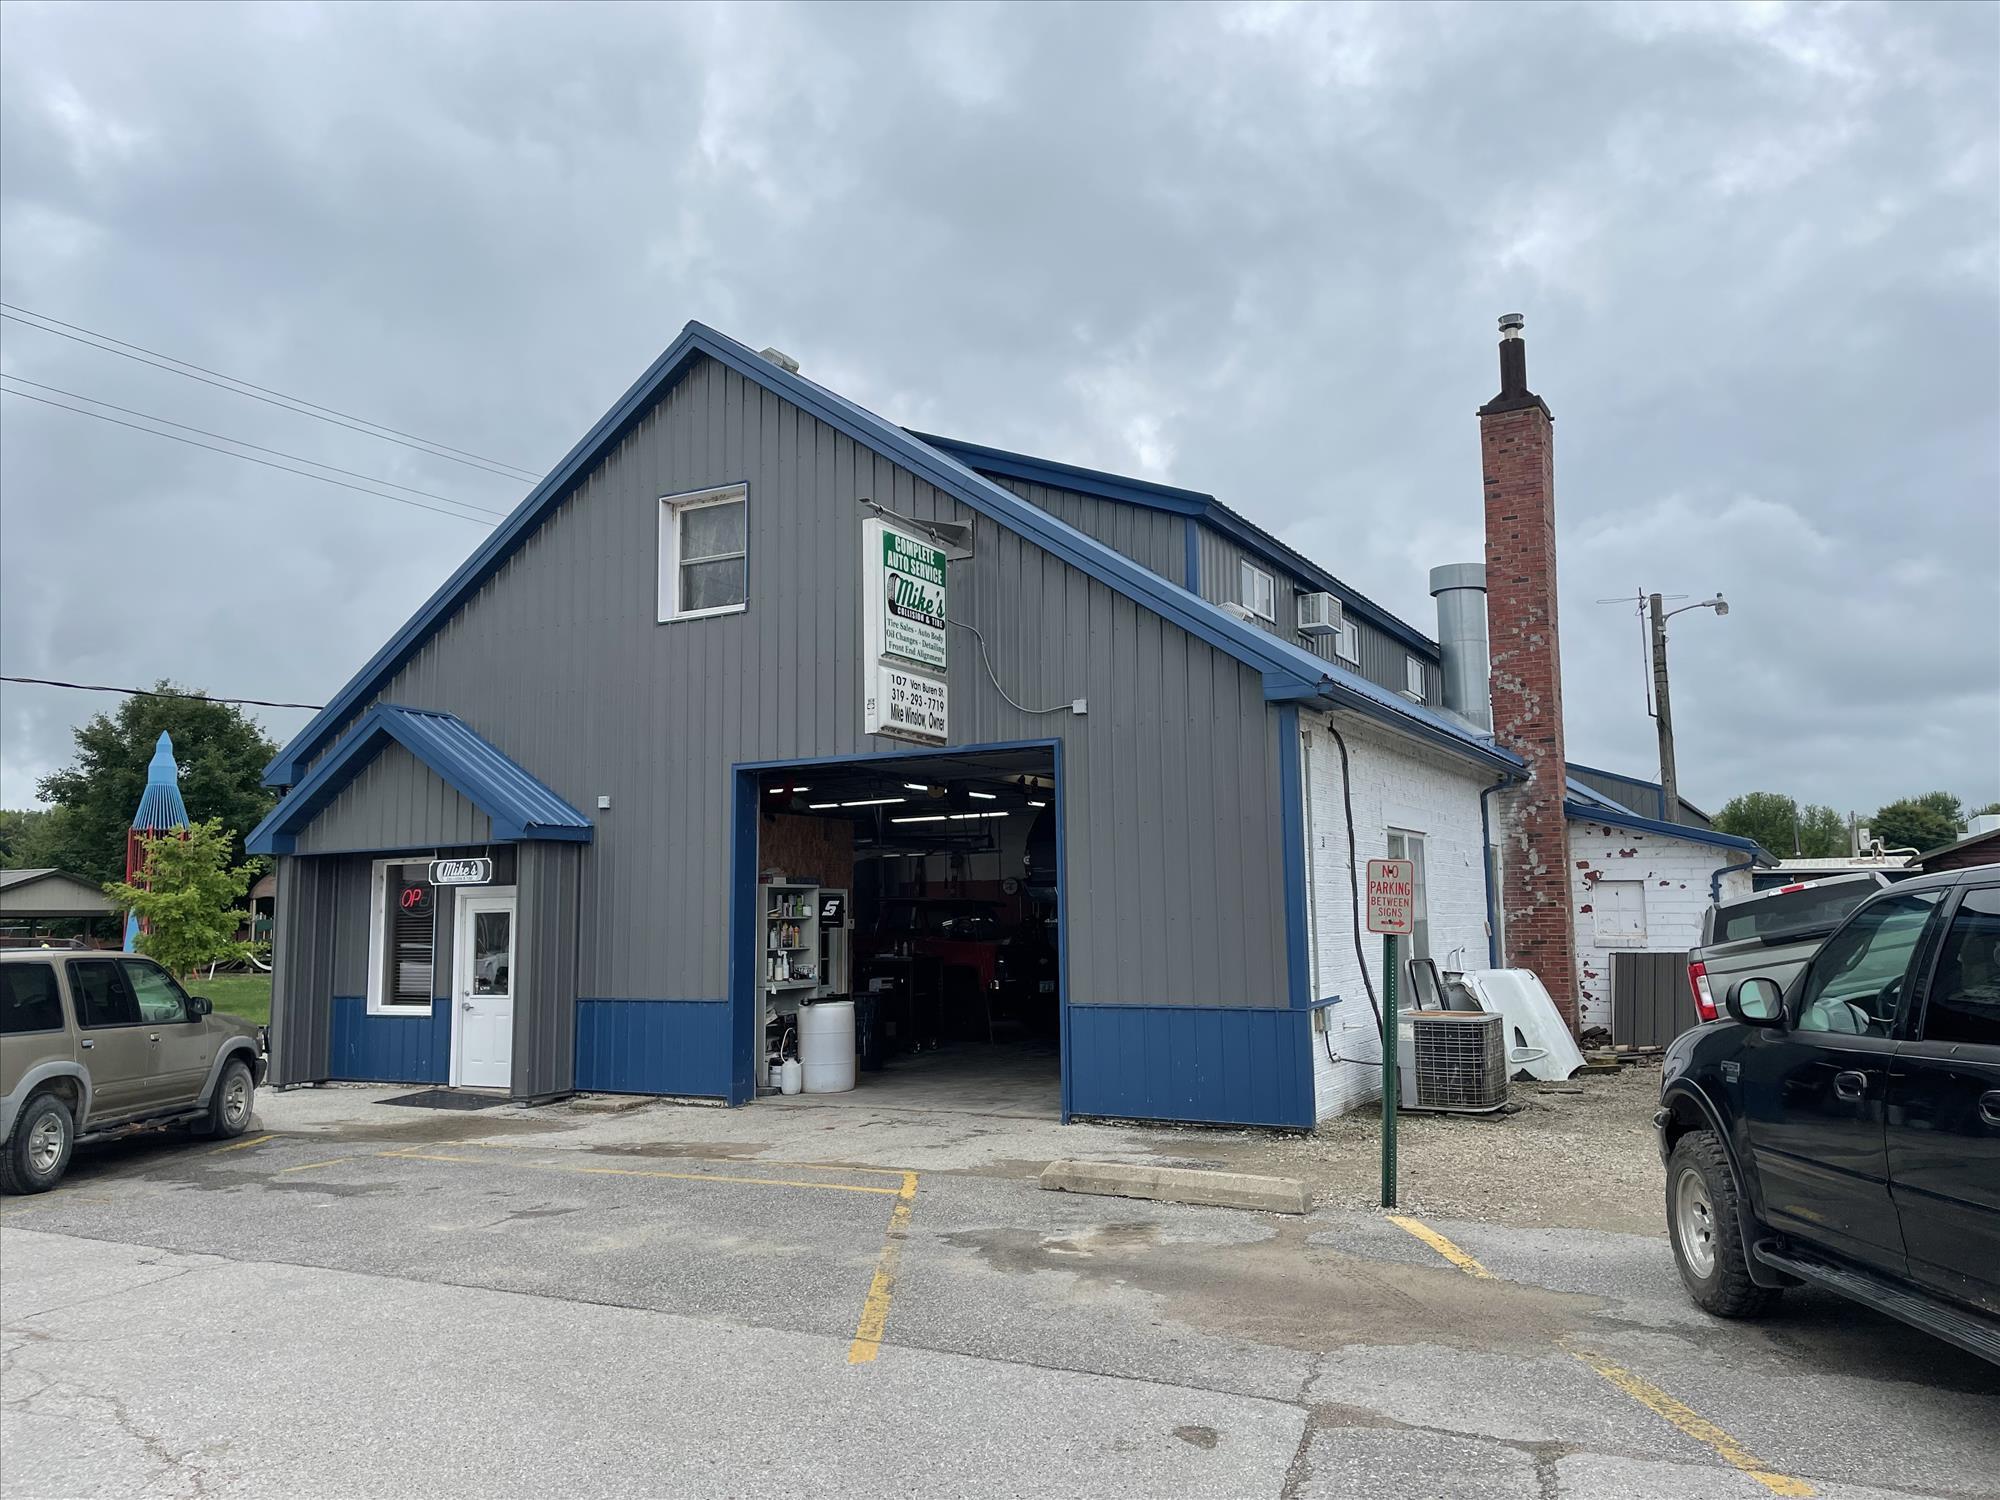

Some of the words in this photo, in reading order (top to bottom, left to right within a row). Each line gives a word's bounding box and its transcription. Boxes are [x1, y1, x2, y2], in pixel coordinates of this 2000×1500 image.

[895, 536, 934, 565] COMPLETE
[888, 550, 908, 572] AUTO
[911, 559, 942, 584] SERVICE
[896, 578, 944, 618] Mike's
[897, 607, 924, 622] COLLISION
[932, 618, 942, 628] TIRE
[887, 619, 899, 628] Tire
[901, 622, 914, 633] Sales
[918, 629, 930, 638] Auto
[931, 632, 944, 644] Body
[889, 641, 904, 652] Front
[906, 646, 916, 655] End
[917, 649, 942, 663] Alignment
[896, 632, 918, 646] Changes
[922, 640, 944, 655] Detailing
[892, 675, 906, 686] 107
[910, 679, 921, 690] Van
[923, 683, 937, 696] Buren
[891, 703, 904, 722] Mike
[929, 713, 944, 731] Owner
[444, 862, 478, 876] Mike's
[1383, 865, 1399, 878] NO
[1371, 881, 1410, 896] PARKING
[1371, 897, 1409, 907] BETWEEN
[1378, 908, 1402, 917] SIGNS
